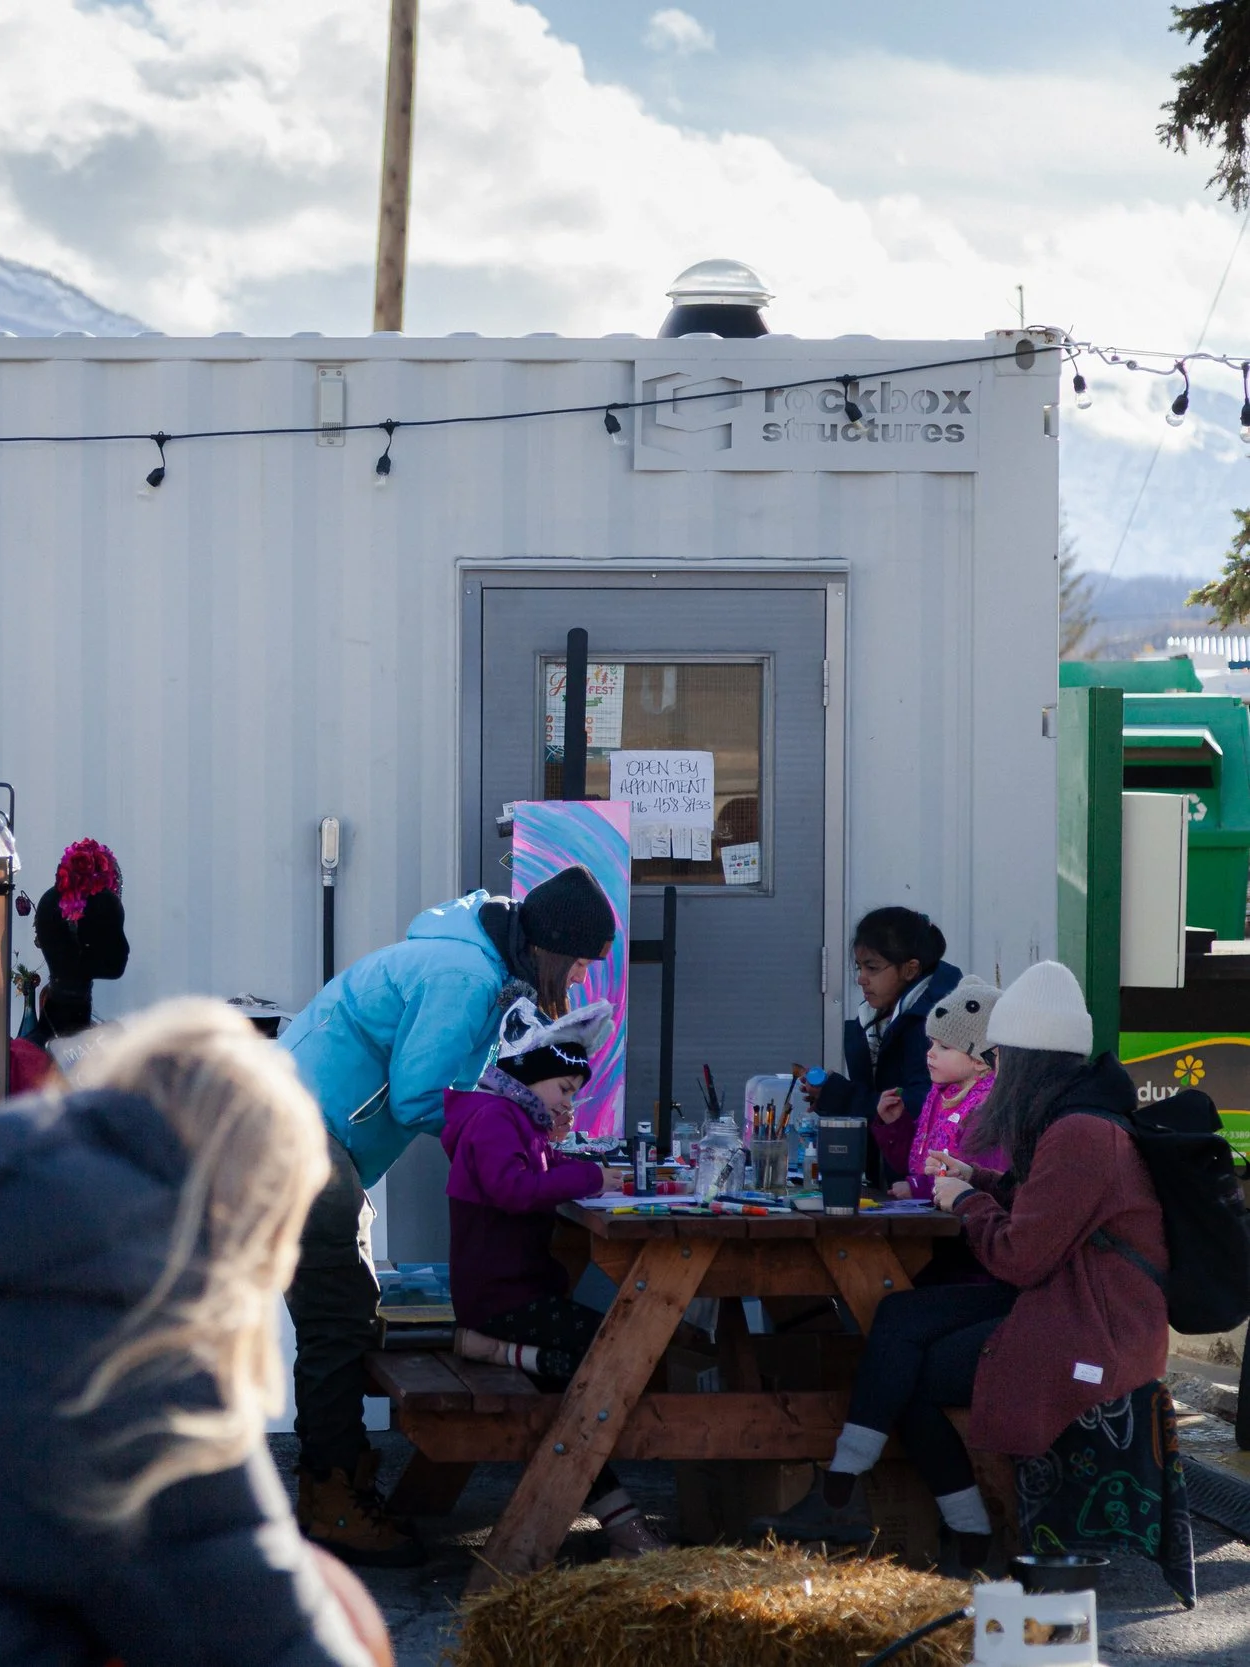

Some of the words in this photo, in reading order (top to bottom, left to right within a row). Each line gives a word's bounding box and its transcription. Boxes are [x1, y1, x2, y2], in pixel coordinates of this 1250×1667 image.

[764, 380, 973, 415] rockbox
[762, 417, 966, 443] structures
[626, 759, 670, 776] OPEN
[620, 778, 706, 795] APPOINTMENT
